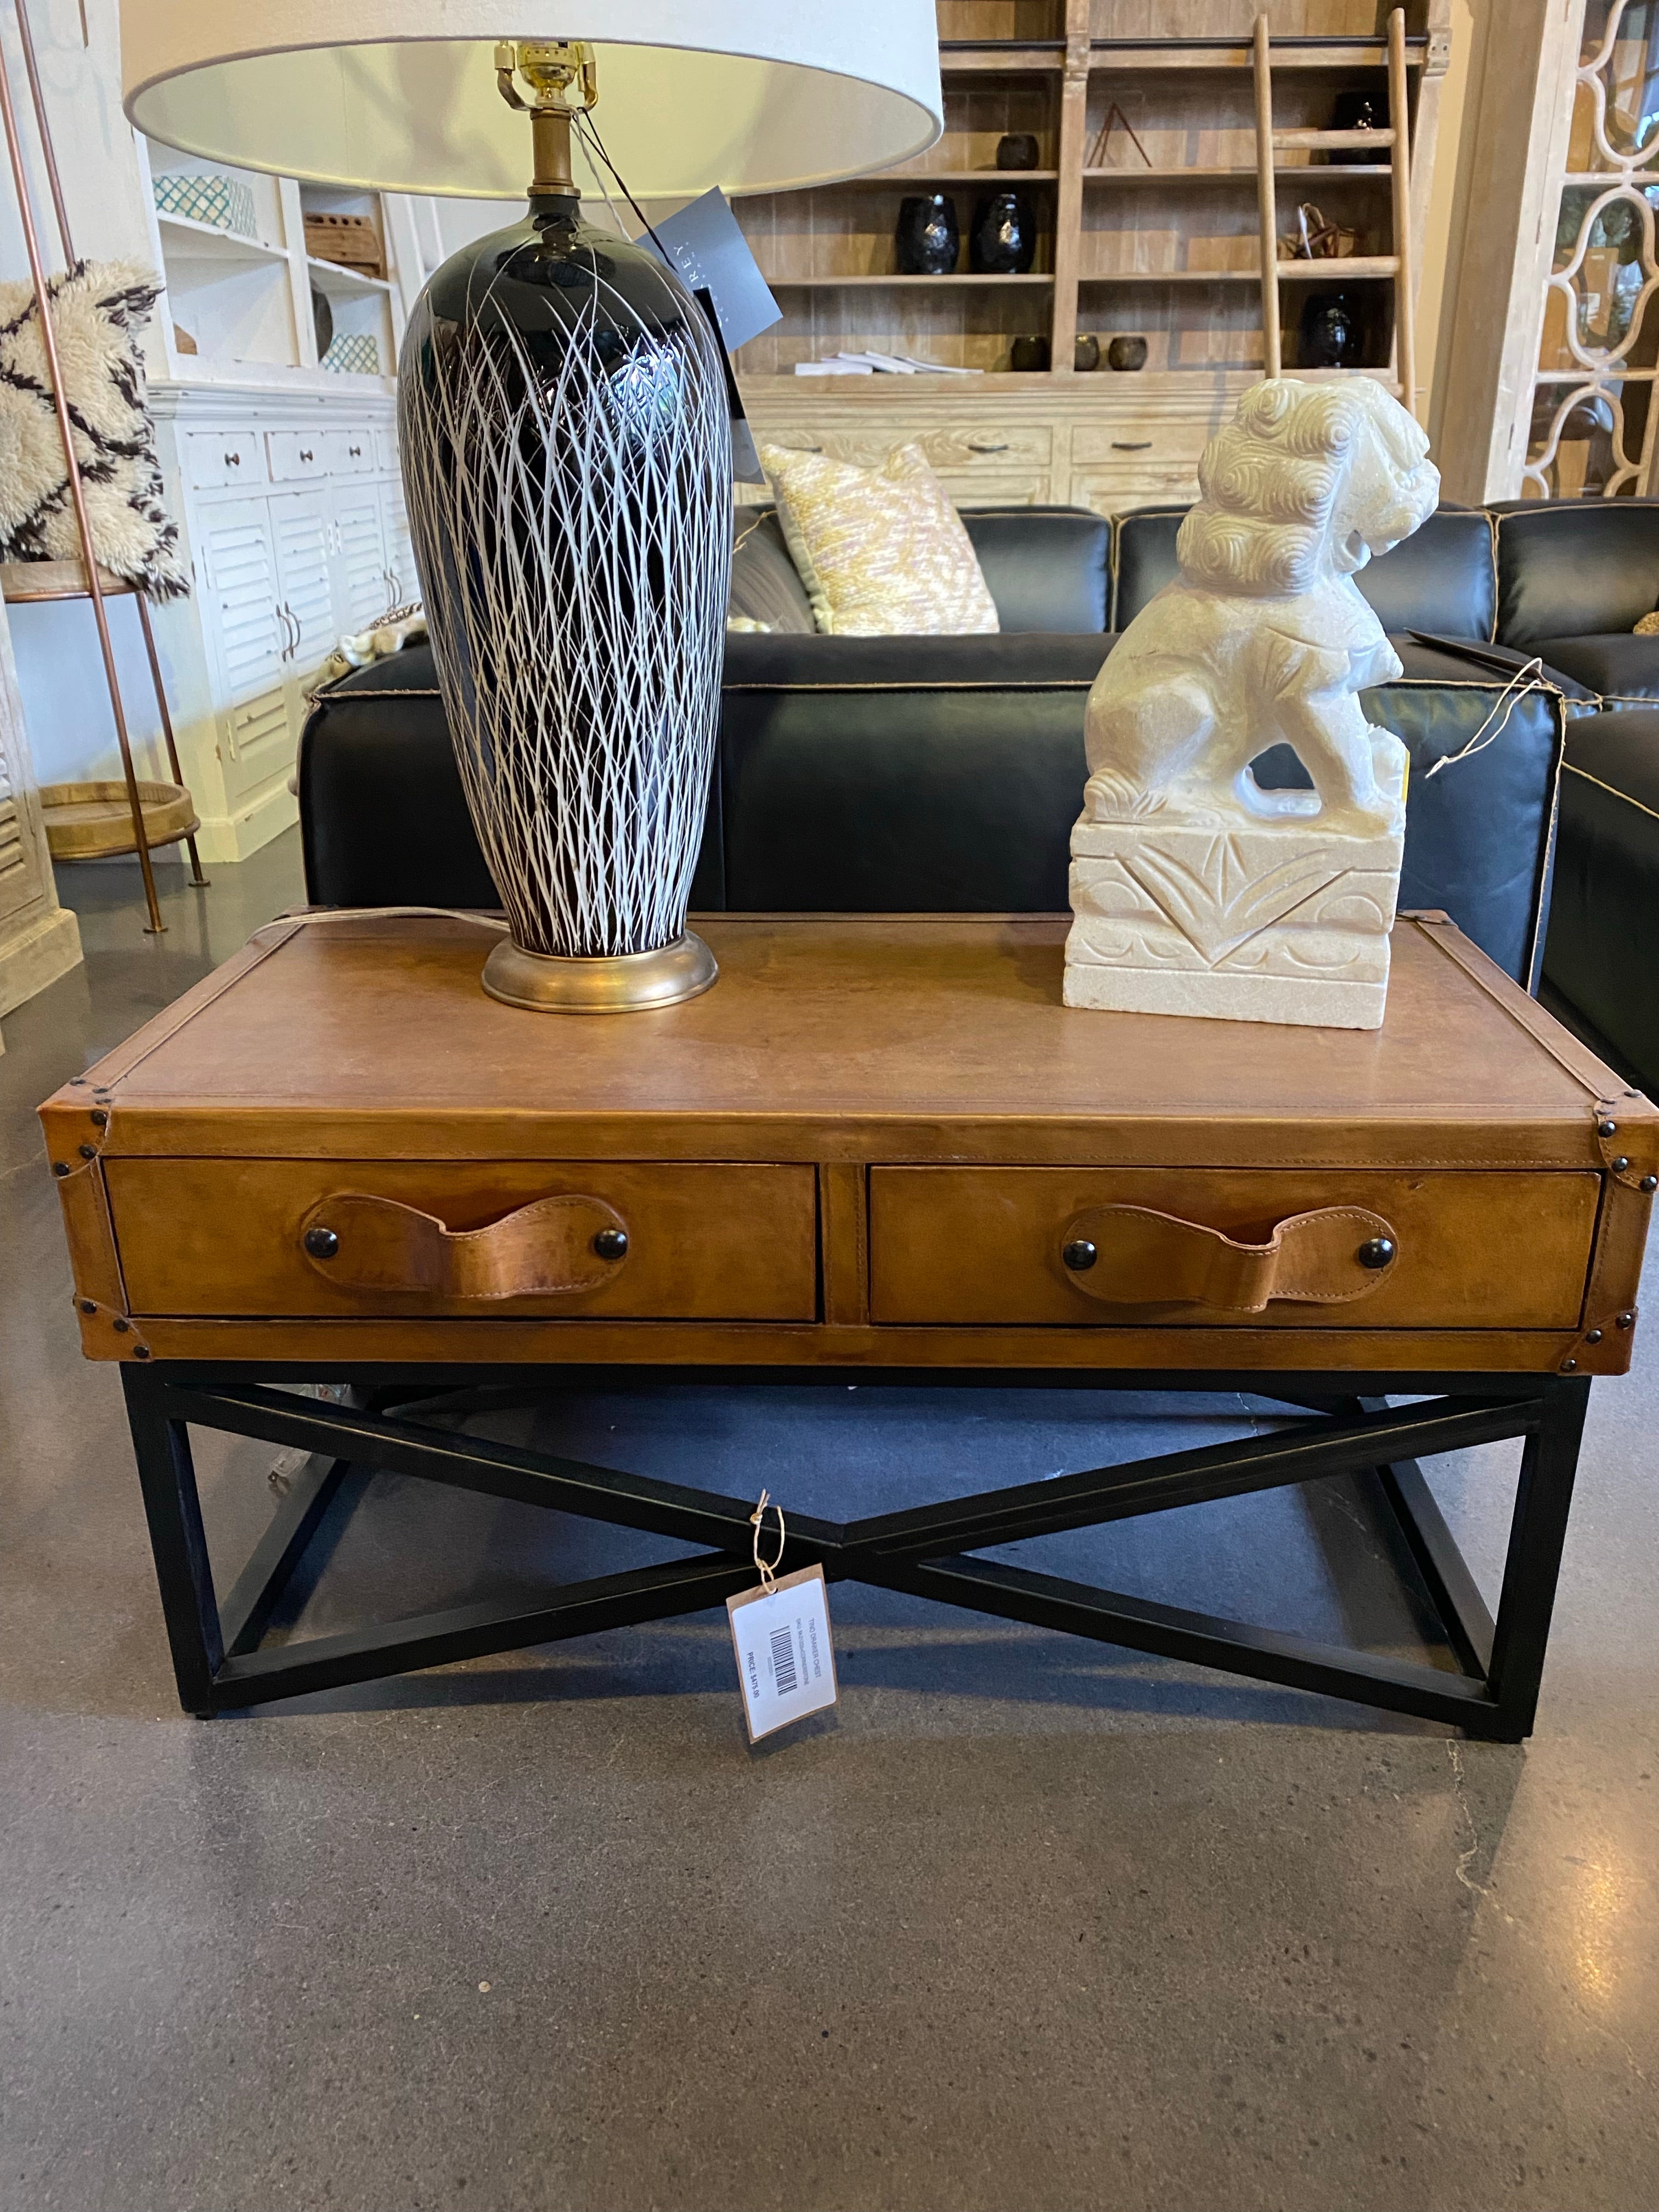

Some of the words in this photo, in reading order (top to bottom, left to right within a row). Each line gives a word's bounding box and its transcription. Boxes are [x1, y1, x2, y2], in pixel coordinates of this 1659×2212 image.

[810, 1632, 819, 1659] DRAWER
[747, 1651, 756, 1674] PRICE:
[813, 1658, 821, 1678] CHEST
[750, 1674, 760, 1699] $475.00
